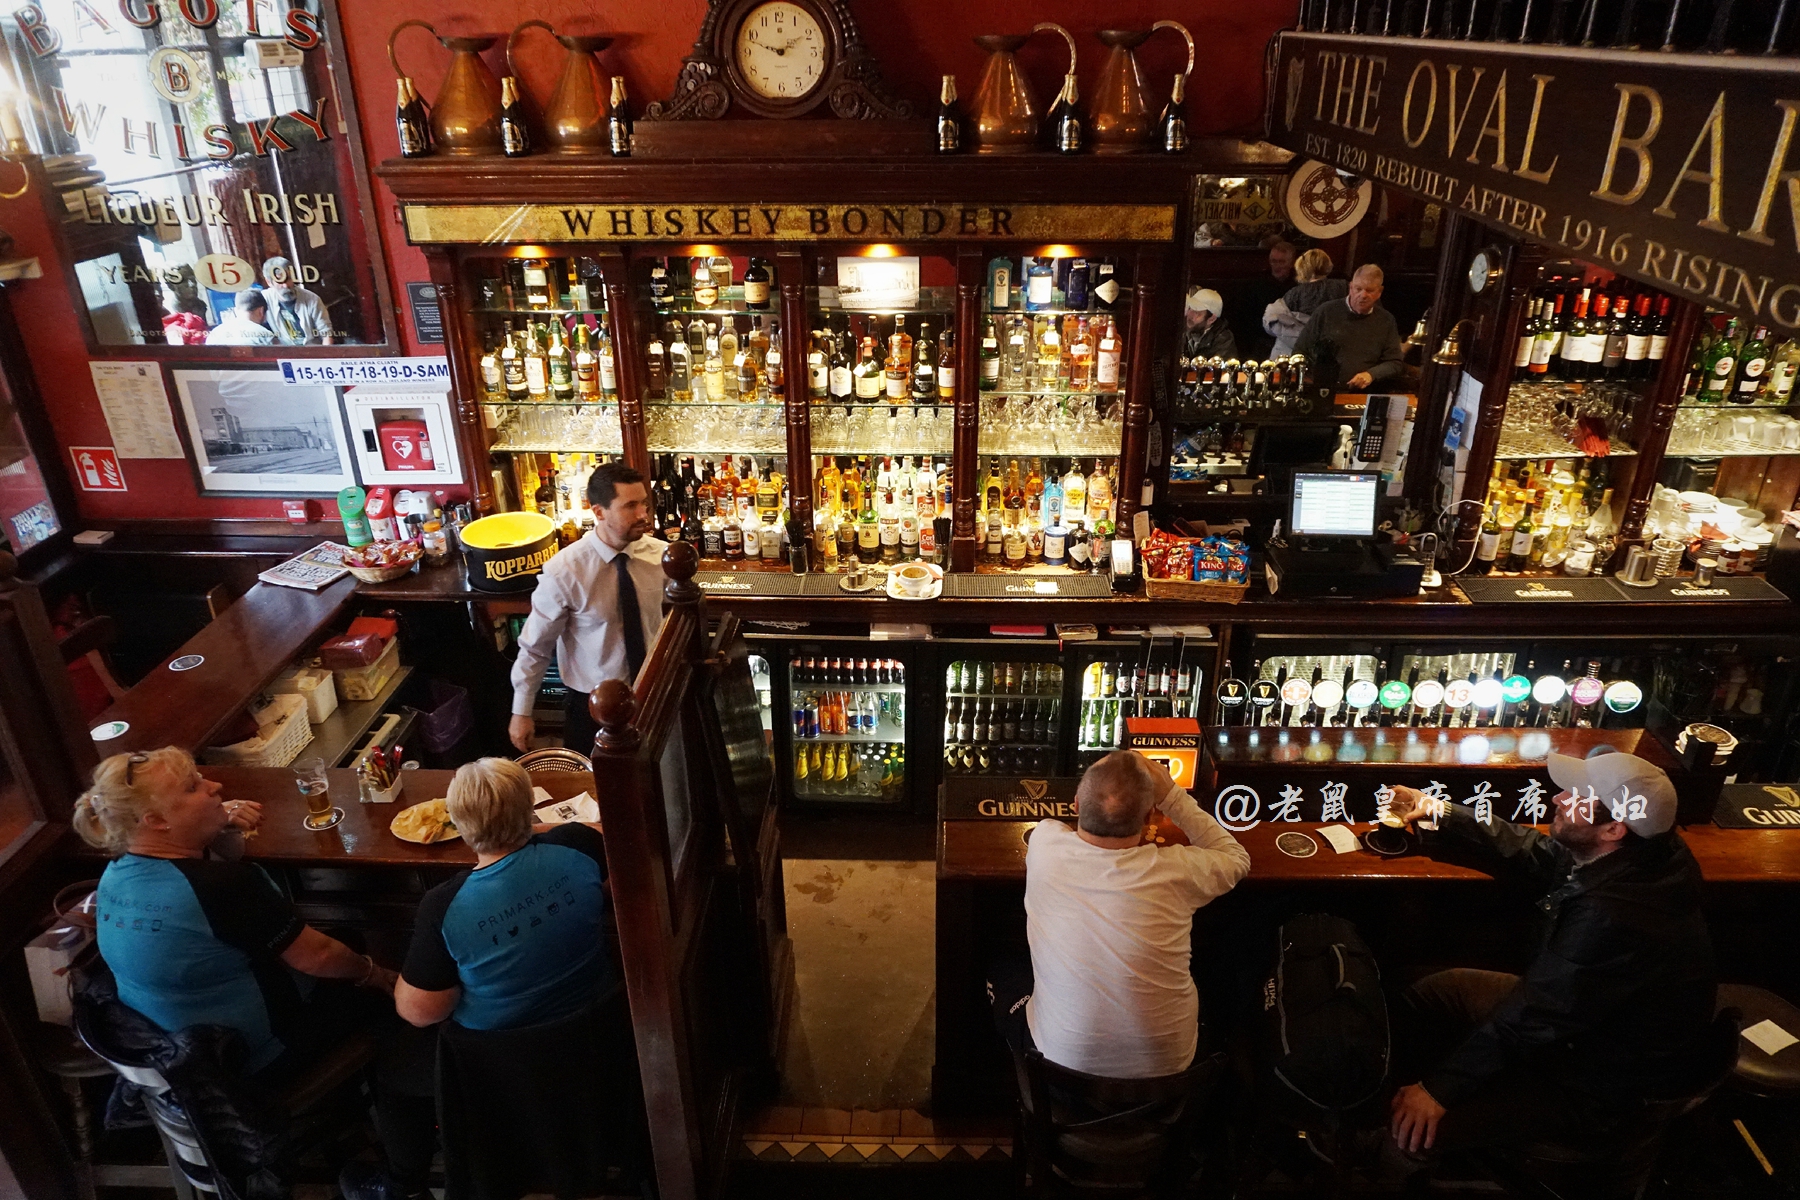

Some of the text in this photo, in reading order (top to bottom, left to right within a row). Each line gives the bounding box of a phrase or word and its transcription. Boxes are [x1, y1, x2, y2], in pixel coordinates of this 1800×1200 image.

[761, 16, 768, 27] 11
[774, 11, 784, 23] 12
[793, 16, 797, 27] 1
[12, 0, 318, 57] BAGOTS
[748, 29, 759, 40] 10
[804, 28, 812, 40] 2
[744, 48, 752, 57] 9
[810, 46, 818, 58] 3
[749, 65, 758, 76] 8
[804, 65, 812, 76] 4
[762, 77, 770, 89] 7
[778, 82, 786, 93] 6
[795, 77, 802, 88] 5
[1313, 50, 1388, 136] THE
[1402, 59, 1559, 184] OVAL
[52, 86, 332, 161] WHISKY
[80, 188, 342, 228] LIQUEUR IRISH
[559, 207, 1016, 236] WHISKEY BONDER
[1305, 133, 1800, 328] EST. 1820 REBUILT AFTER 1916 RISING
[101, 263, 320, 286] YEARS 15 OLD
[296, 364, 449, 380] 15-16-17-18-19-D-SAM
[1200, 561, 1224, 569] KING
[698, 581, 753, 590] GUINNESS
[1514, 589, 1574, 597] GUINNESS
[1670, 588, 1730, 597] GUINNESS
[1132, 737, 1197, 746] GUINNESS
[978, 799, 1080, 817] GUINNES
[477, 874, 570, 932] PRIMARK.com
